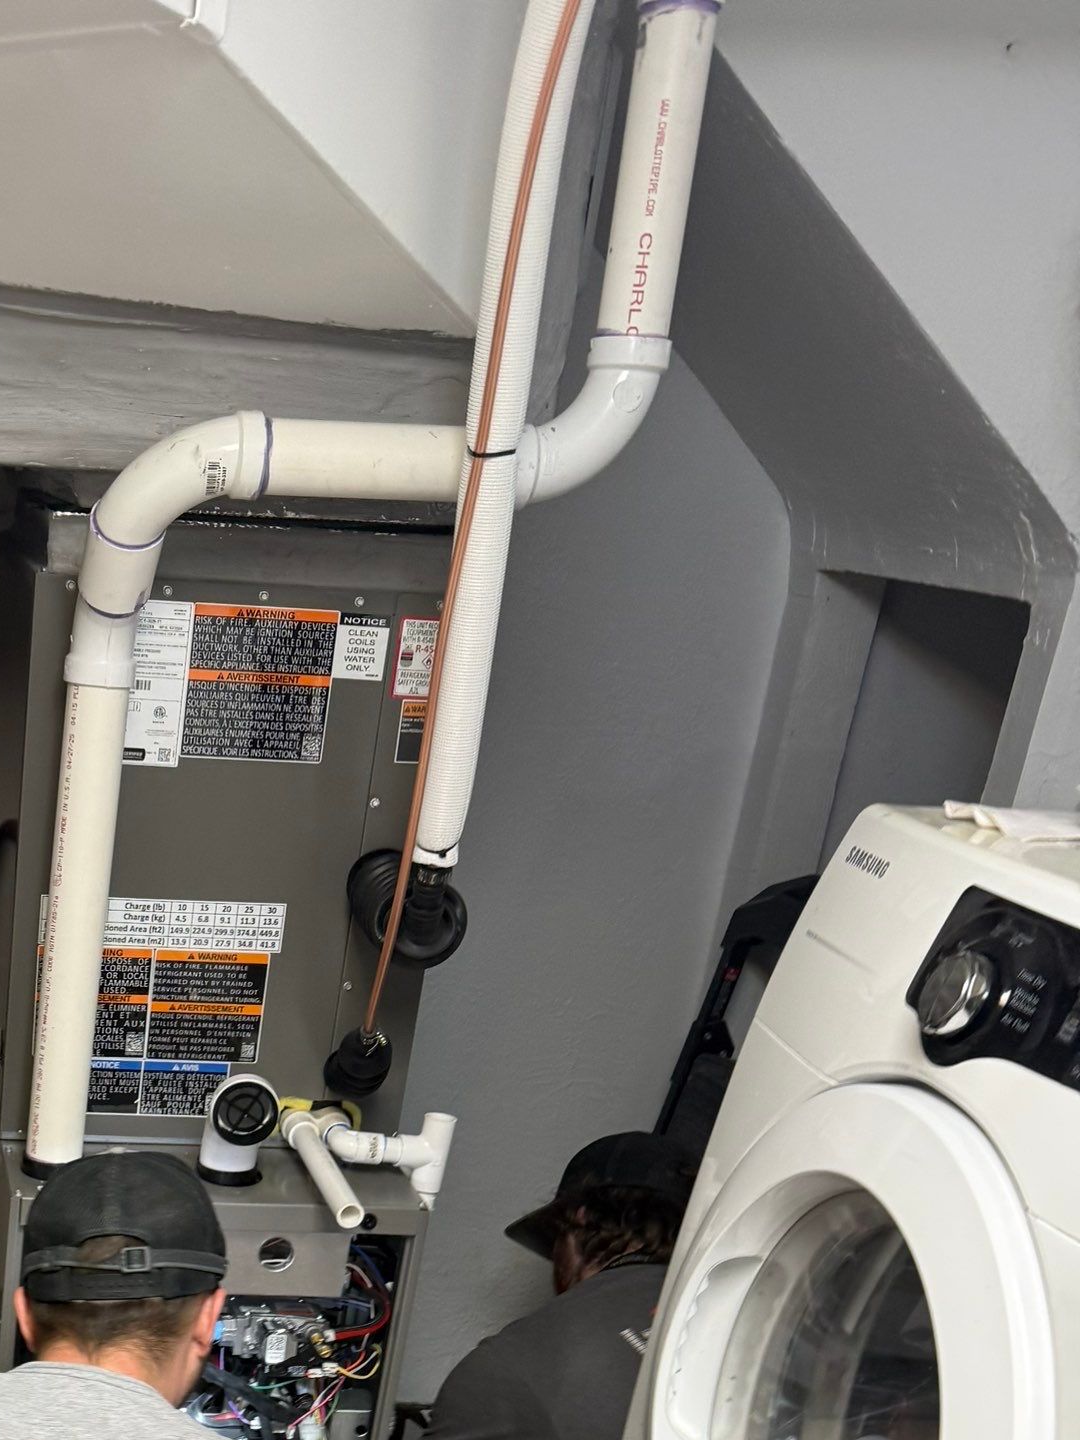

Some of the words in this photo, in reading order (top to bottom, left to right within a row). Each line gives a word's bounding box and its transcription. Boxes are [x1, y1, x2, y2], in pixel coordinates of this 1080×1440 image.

[626, 233, 652, 336] CHARLO
[246, 610, 295, 619] WARNING
[195, 616, 212, 625] RISK
[216, 617, 227, 625] OF
[255, 620, 299, 630] AUXILIARY
[301, 622, 336, 631] DEVICES
[344, 616, 386, 626] NOTICE
[194, 625, 221, 634] WHICH
[226, 627, 243, 635] MAY
[245, 627, 255, 636] BE
[257, 628, 293, 638] IGNITION
[298, 630, 335, 640] SOURCES
[348, 629, 378, 637] CLEAN
[193, 633, 220, 643] SHALL
[222, 635, 238, 644] NOT
[243, 636, 252, 645] BE
[257, 637, 301, 647] INSTALLED
[304, 639, 313, 648] IN
[319, 640, 333, 649] THE
[348, 638, 375, 646] COILS
[243, 645, 268, 654] OTHER
[271, 647, 292, 656] THAN
[294, 648, 333, 657] AUXILIARY
[346, 647, 375, 655] USING
[415, 645, 434, 653] R-45
[192, 651, 225, 660] DEVICES
[227, 653, 253, 662] LISTED
[257, 654, 271, 663] FOR
[274, 655, 289, 664] USE
[292, 656, 312, 664] WITH
[318, 657, 331, 666] THE
[191, 660, 220, 669] SPECIFIC
[264, 663, 276, 672] SEE
[226, 672, 301, 684] AVERTISSEMENT
[188, 681, 217, 690] RISQUE
[267, 686, 280, 694] LES
[281, 686, 327, 696] DISPOSITIFS
[188, 691, 233, 701] AUXILIAIRES
[234, 693, 249, 701] QUI
[251, 694, 285, 703] PEUVENT
[312, 697, 325, 705] DES
[187, 700, 218, 709] SOURCES
[283, 704, 293, 712] NE
[294, 705, 324, 714] DOIVENT
[186, 709, 199, 717] PAS
[255, 712, 274, 721] DANS
[276, 713, 284, 721] LE
[313, 715, 323, 723] DE
[271, 722, 284, 731] DES
[265, 731, 284, 740] POUR
[285, 732, 300, 740] UNE
[183, 736, 230, 747] UTILISATION
[234, 738, 253, 747] AVEC
[239, 749, 250, 757] LES
[846, 846, 890, 879] SAMSUNG
[124, 903, 151, 912] Charge
[152, 903, 165, 912] (lb)
[200, 904, 209, 912] 15
[222, 905, 232, 913] 20
[123, 913, 150, 922] Charge
[151, 914, 166, 923] (kg)
[263, 918, 279, 926] 13.6
[149, 926, 165, 934] (ft2)
[128, 936, 146, 944] Area
[147, 937, 165, 945] (m2)
[176, 1004, 245, 1012] AVERTISSEMENT
